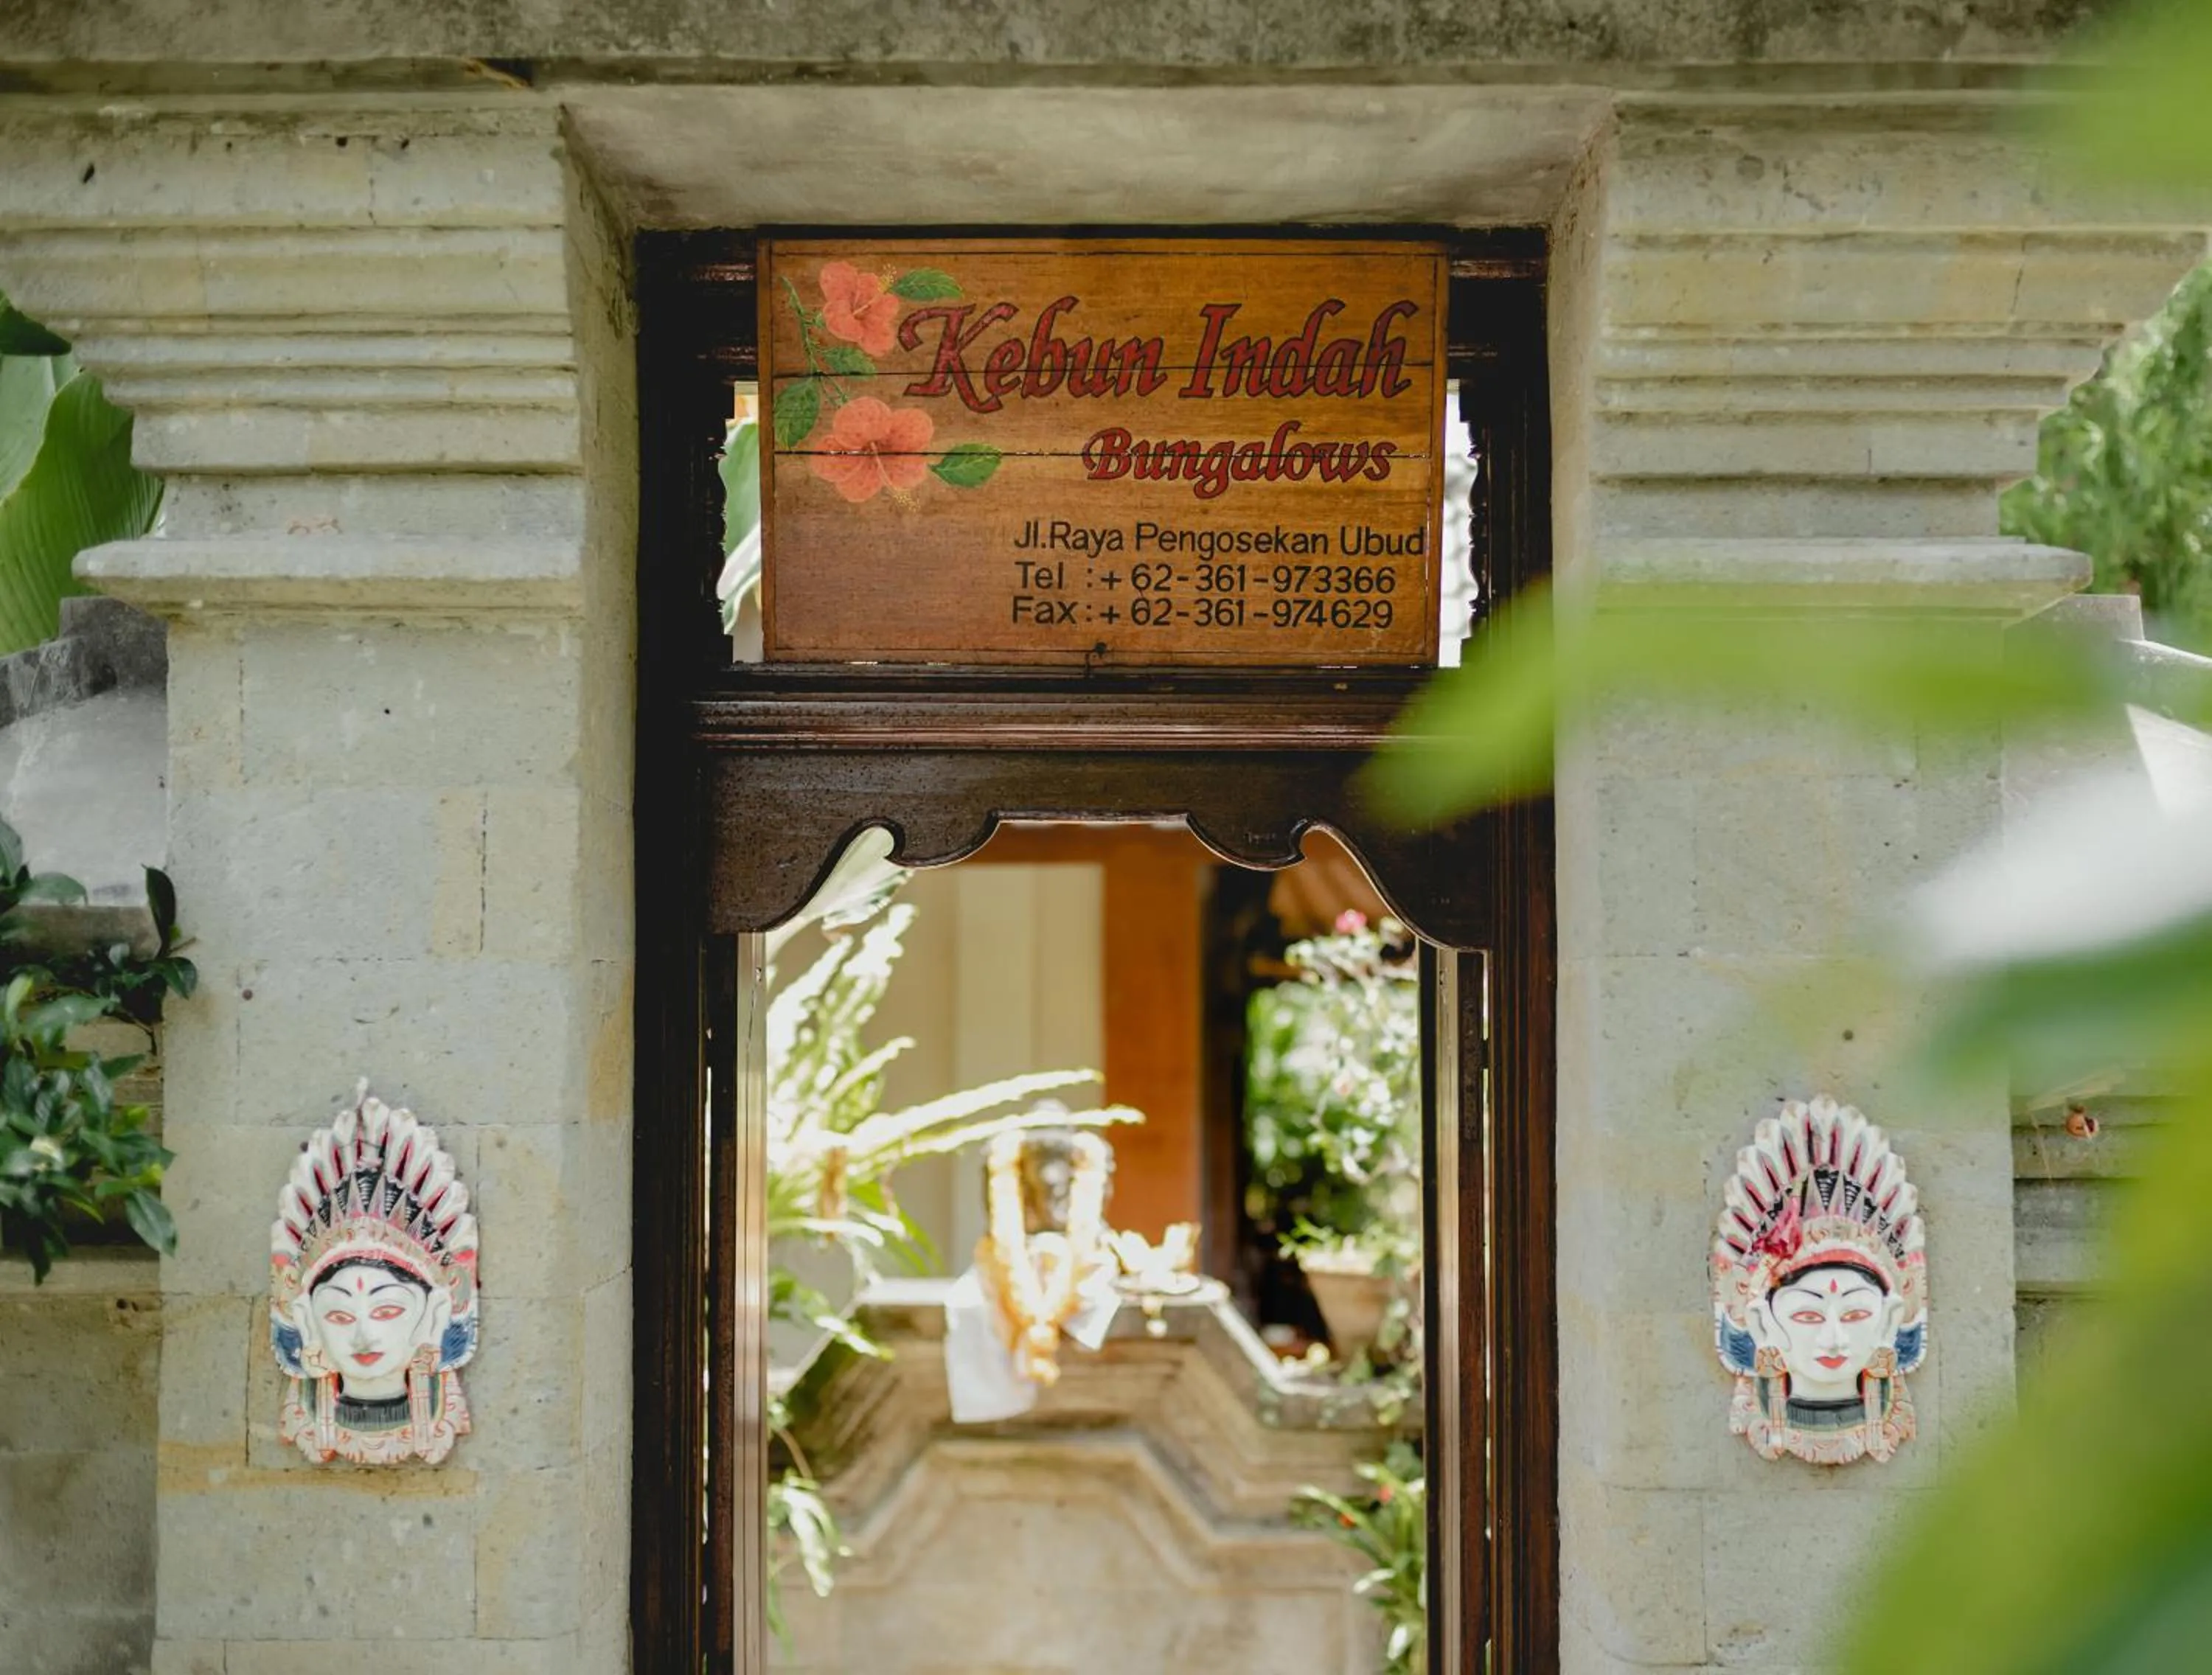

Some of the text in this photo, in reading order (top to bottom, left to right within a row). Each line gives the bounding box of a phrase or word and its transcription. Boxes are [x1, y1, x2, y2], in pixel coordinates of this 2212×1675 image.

[897, 296, 1419, 414] Kebun Indah
[1082, 421, 1397, 499] Bungalows
[1135, 523, 1328, 560] Pengosekan
[1340, 526, 1426, 556] Ubud
